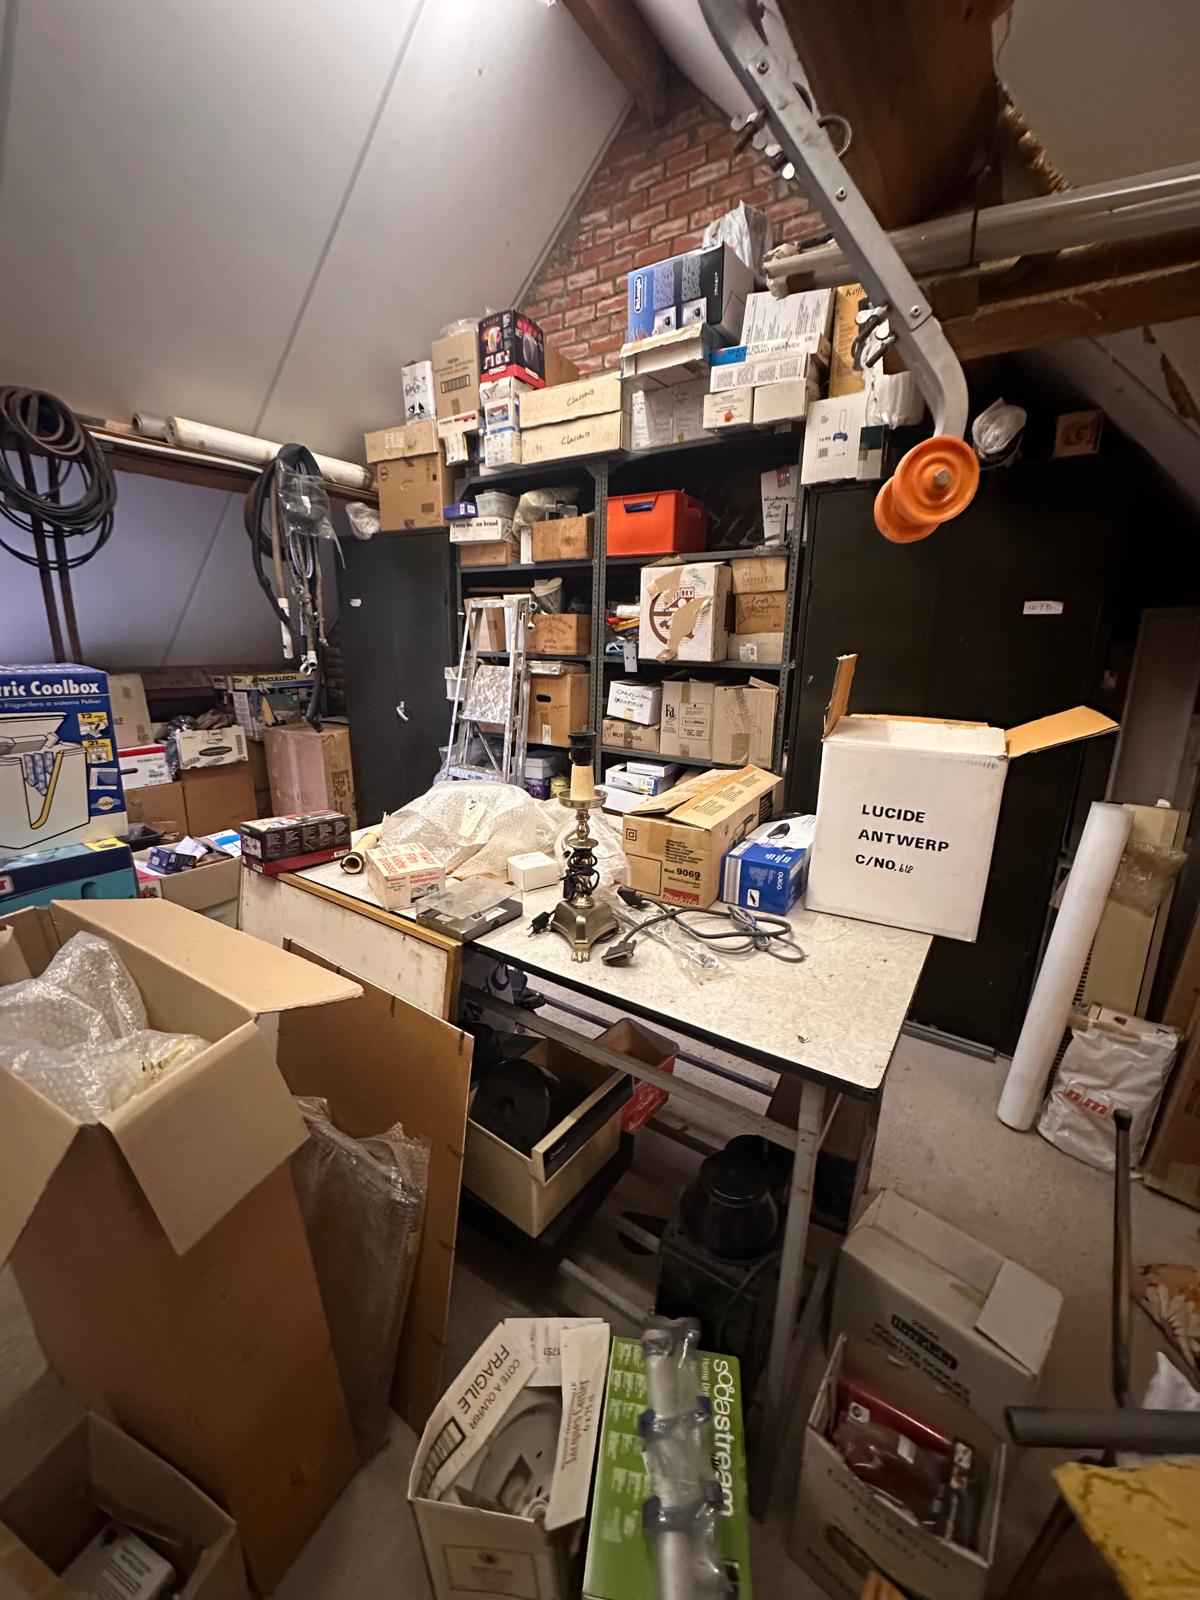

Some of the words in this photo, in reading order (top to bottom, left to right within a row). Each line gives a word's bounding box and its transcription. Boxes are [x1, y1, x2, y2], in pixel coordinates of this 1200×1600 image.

[30, 679, 101, 696] Coolbox
[862, 804, 926, 823] LUCIDE
[858, 829, 950, 852] ANTWERP
[855, 854, 897, 872] C/NO.
[676, 868, 701, 880] 9069
[776, 871, 784, 891] QUIGG
[457, 1343, 511, 1415] FRAGILE
[468, 1391, 498, 1431] OUVRIR
